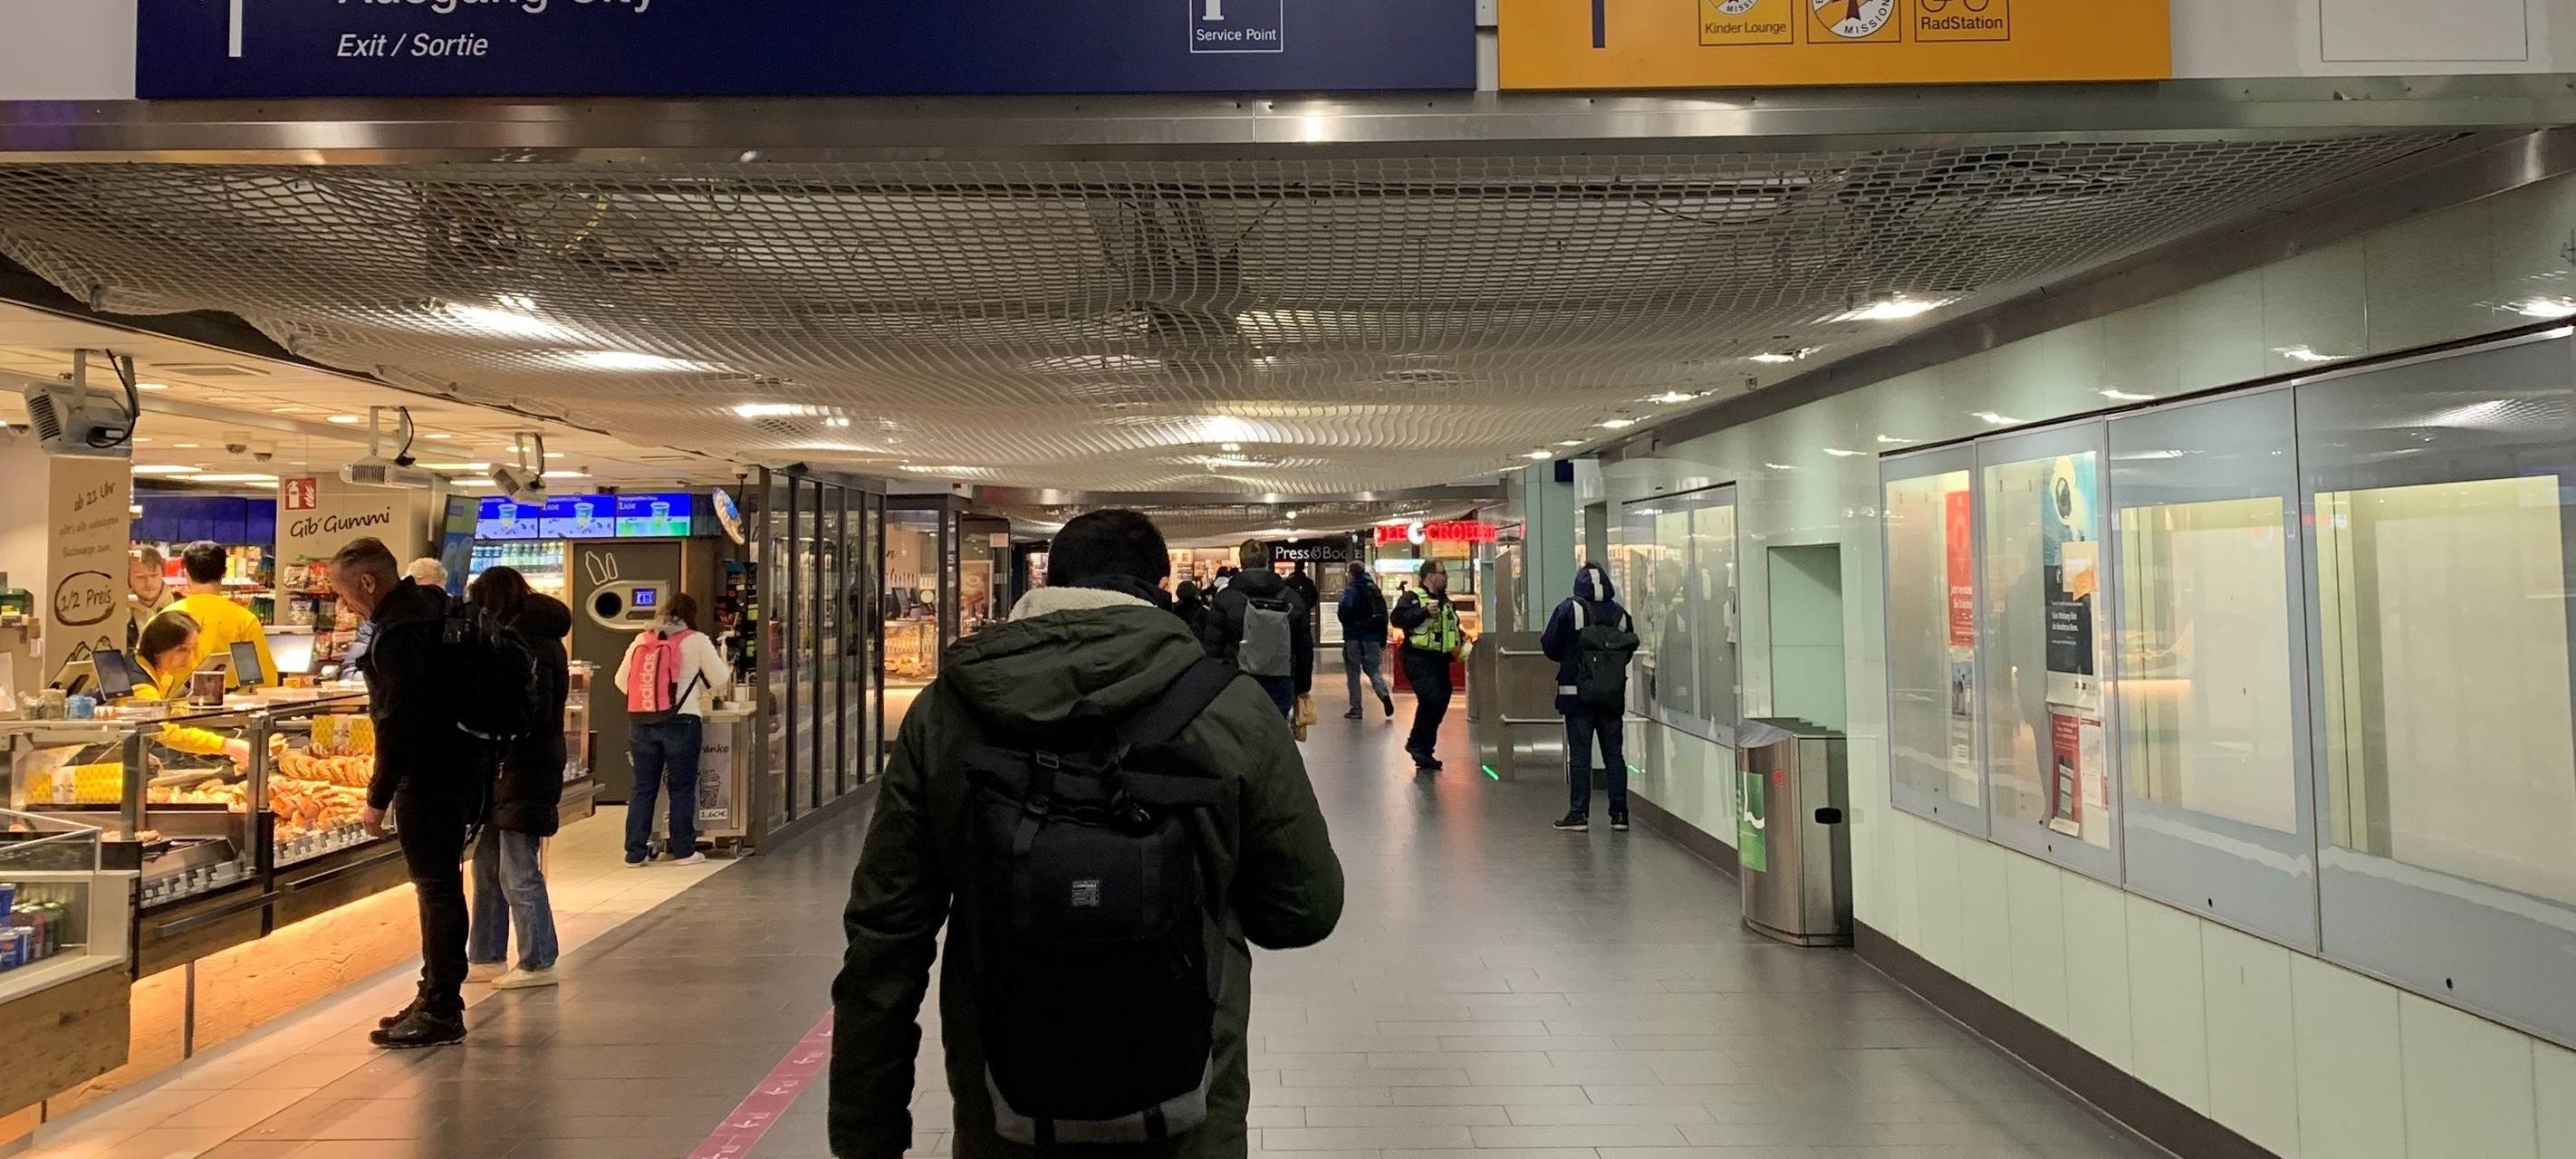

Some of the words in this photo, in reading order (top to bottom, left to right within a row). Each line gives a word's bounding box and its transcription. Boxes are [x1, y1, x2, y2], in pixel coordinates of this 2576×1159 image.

[1705, 22, 1742, 34] Kinder
[1745, 22, 1787, 34] Lounge
[1920, 15, 2004, 30] RadStation
[1196, 28, 1243, 41] Service
[1245, 28, 1277, 41] Point
[336, 33, 387, 57] Exit
[390, 34, 407, 57] /
[410, 33, 489, 57] Sortie
[100, 481, 116, 498] Uhr
[323, 506, 390, 533] Gummi
[61, 590, 80, 612] 1/2
[86, 584, 112, 608] Preis
[639, 651, 658, 711] adidas
